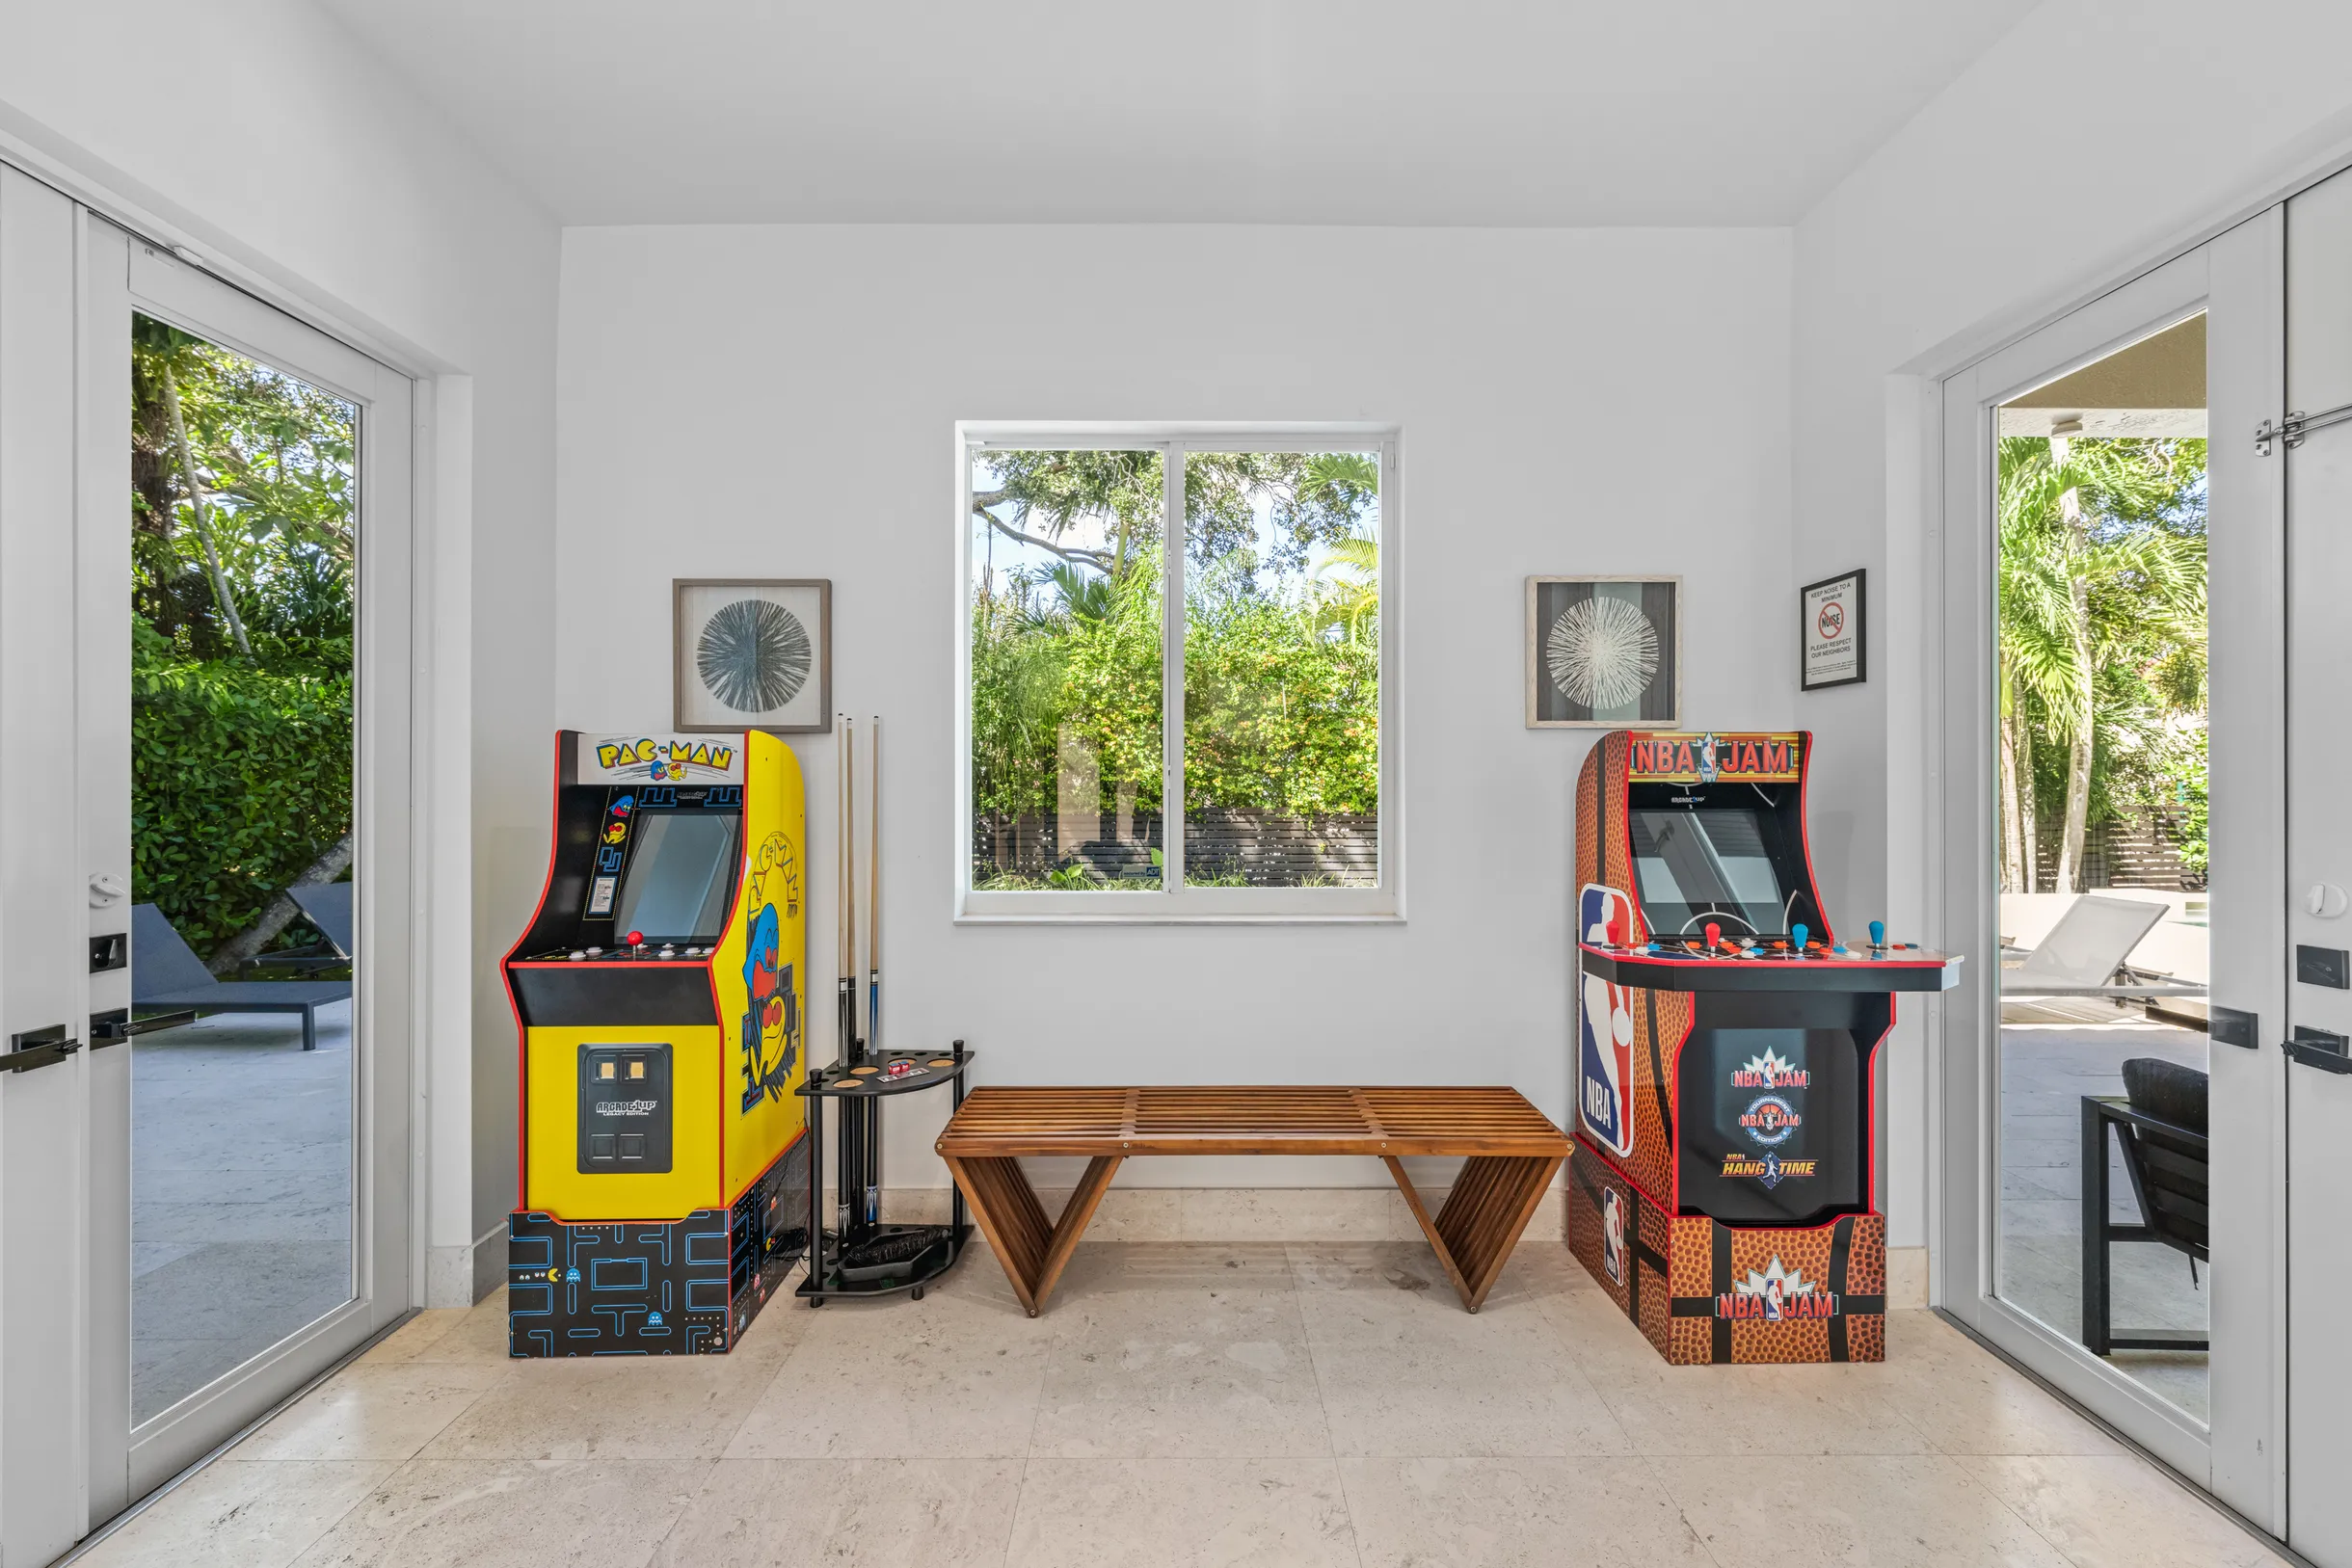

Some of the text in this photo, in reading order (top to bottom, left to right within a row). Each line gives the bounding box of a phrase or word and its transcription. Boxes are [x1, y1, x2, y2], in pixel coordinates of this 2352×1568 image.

[1824, 585, 1838, 595] NOISE
[1821, 593, 1843, 602] MINIMUM
[1810, 637, 1852, 651] PLEASE RESPECT
[1822, 646, 1851, 656] NEIGHBORS
[597, 738, 733, 771] PAC-MAN
[1636, 741, 1789, 774] NBA JAM
[1147, 867, 1160, 876] ADT
[1734, 1070, 1807, 1087] NBA JAM
[1586, 1076, 1612, 1129] NBA
[1750, 1098, 1790, 1113] TOURNAMENT
[1741, 1114, 1799, 1127] NBA JAM
[1723, 1162, 1815, 1175] HANG TIME
[1720, 1291, 1833, 1319] NBA JAM
